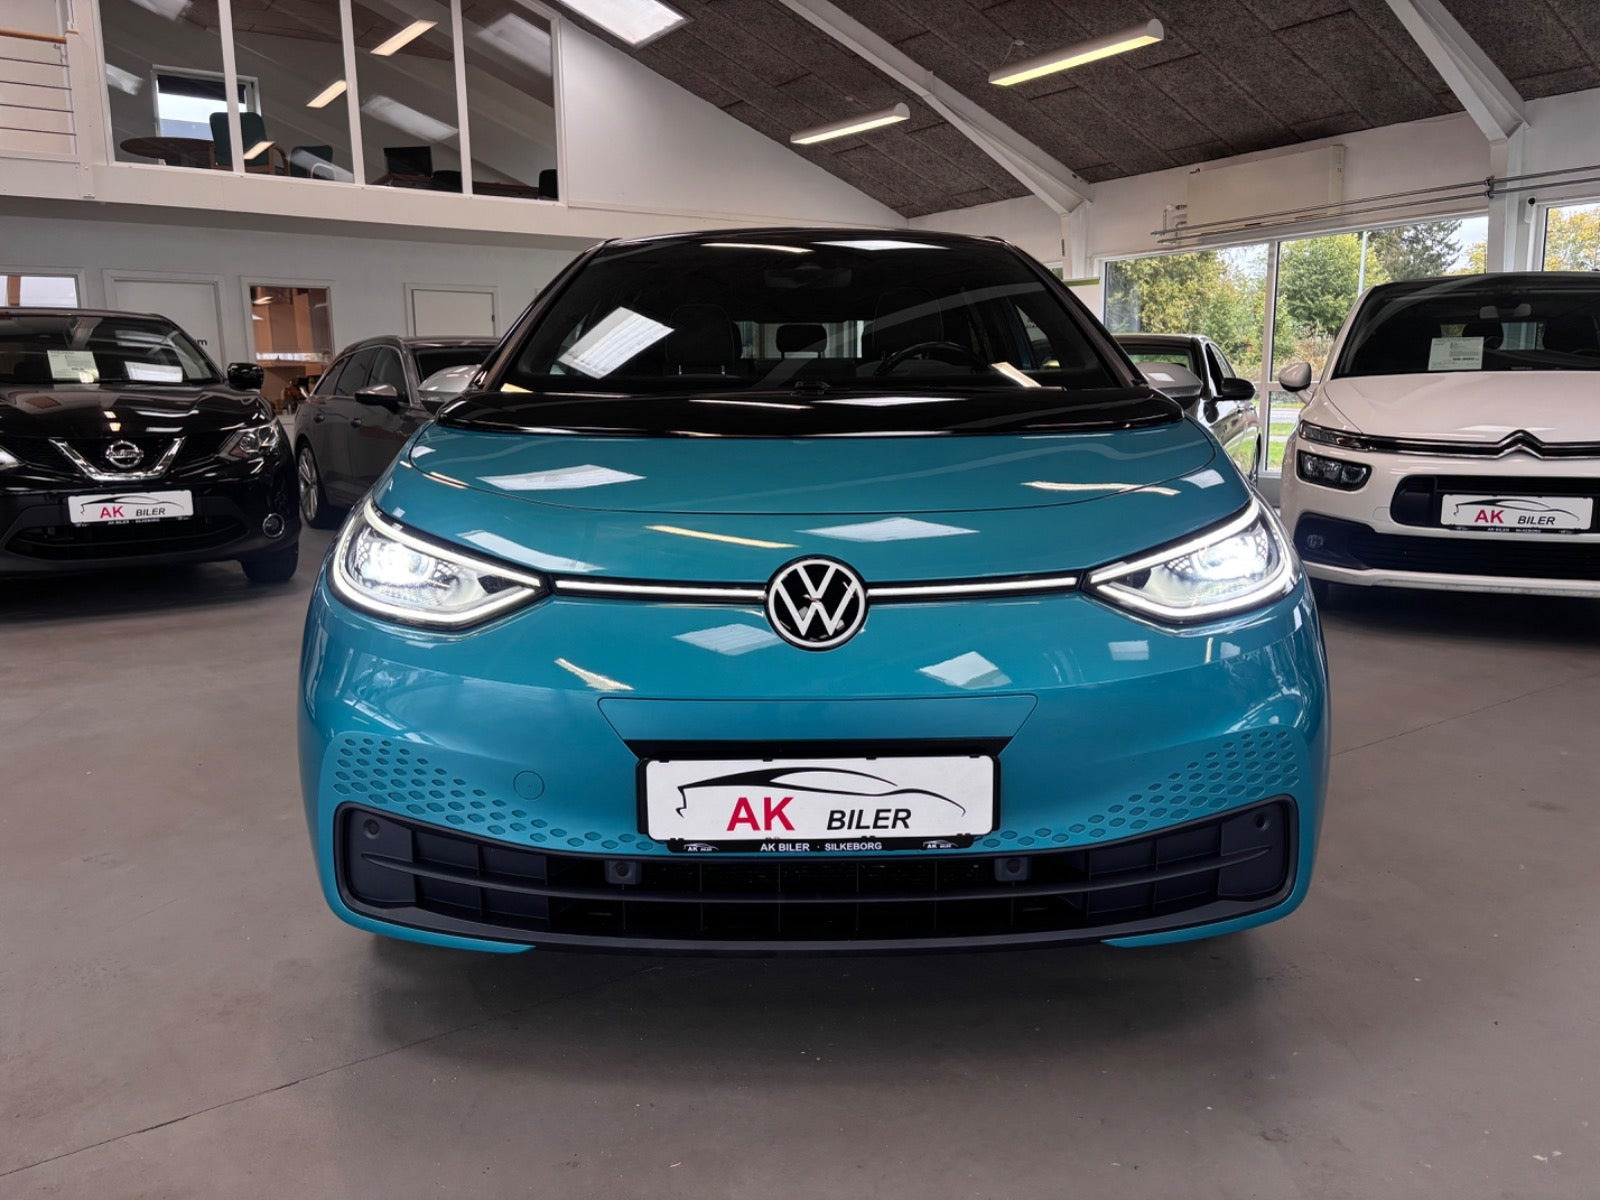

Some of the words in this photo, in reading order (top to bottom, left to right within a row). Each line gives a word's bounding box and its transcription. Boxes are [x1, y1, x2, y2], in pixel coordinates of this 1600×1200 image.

[99, 505, 125, 519] AK
[135, 507, 166, 517] BILER
[1474, 509, 1505, 524] AK
[1517, 515, 1556, 525] BILER
[726, 796, 796, 832] AK
[826, 808, 912, 831] BILER
[760, 843, 776, 852] AK
[778, 842, 811, 852] BILER
[824, 841, 883, 851] SILKEBORG
